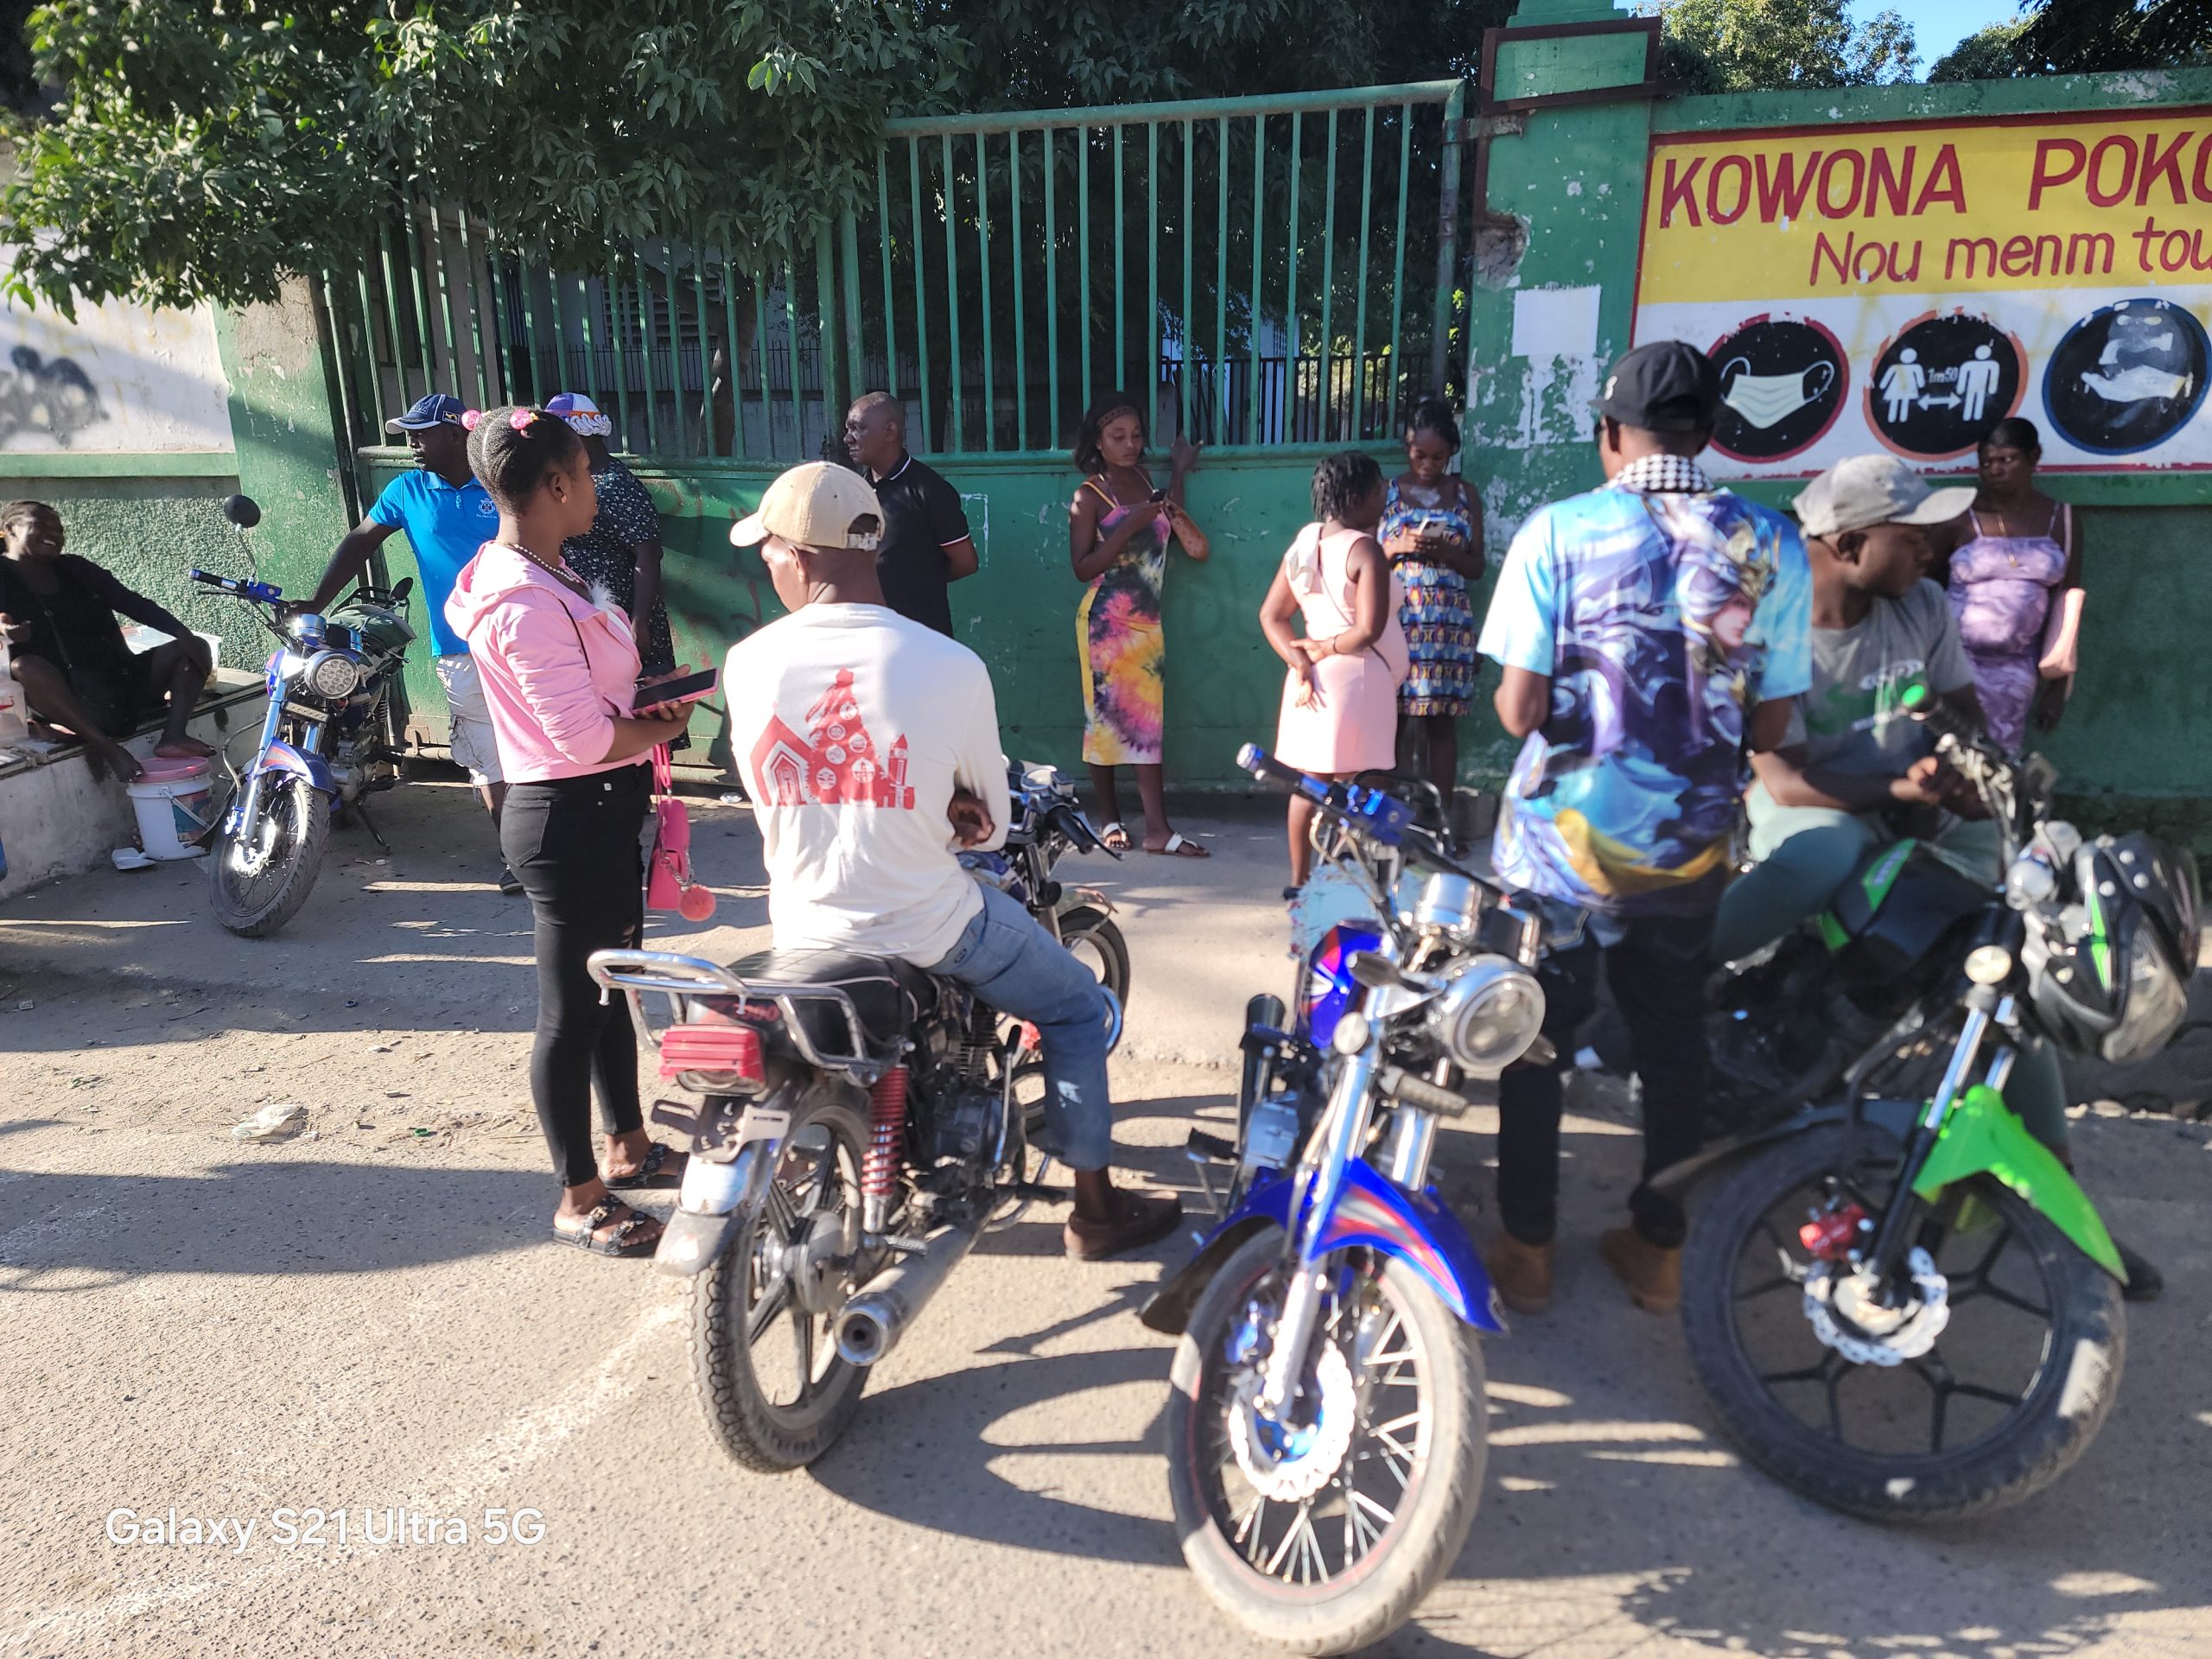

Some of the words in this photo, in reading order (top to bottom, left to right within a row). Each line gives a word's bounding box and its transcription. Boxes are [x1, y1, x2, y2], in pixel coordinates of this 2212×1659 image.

[1659, 143, 1967, 229] KOWONA
[1809, 231, 1923, 286] Nou
[1944, 232, 2115, 280] menm
